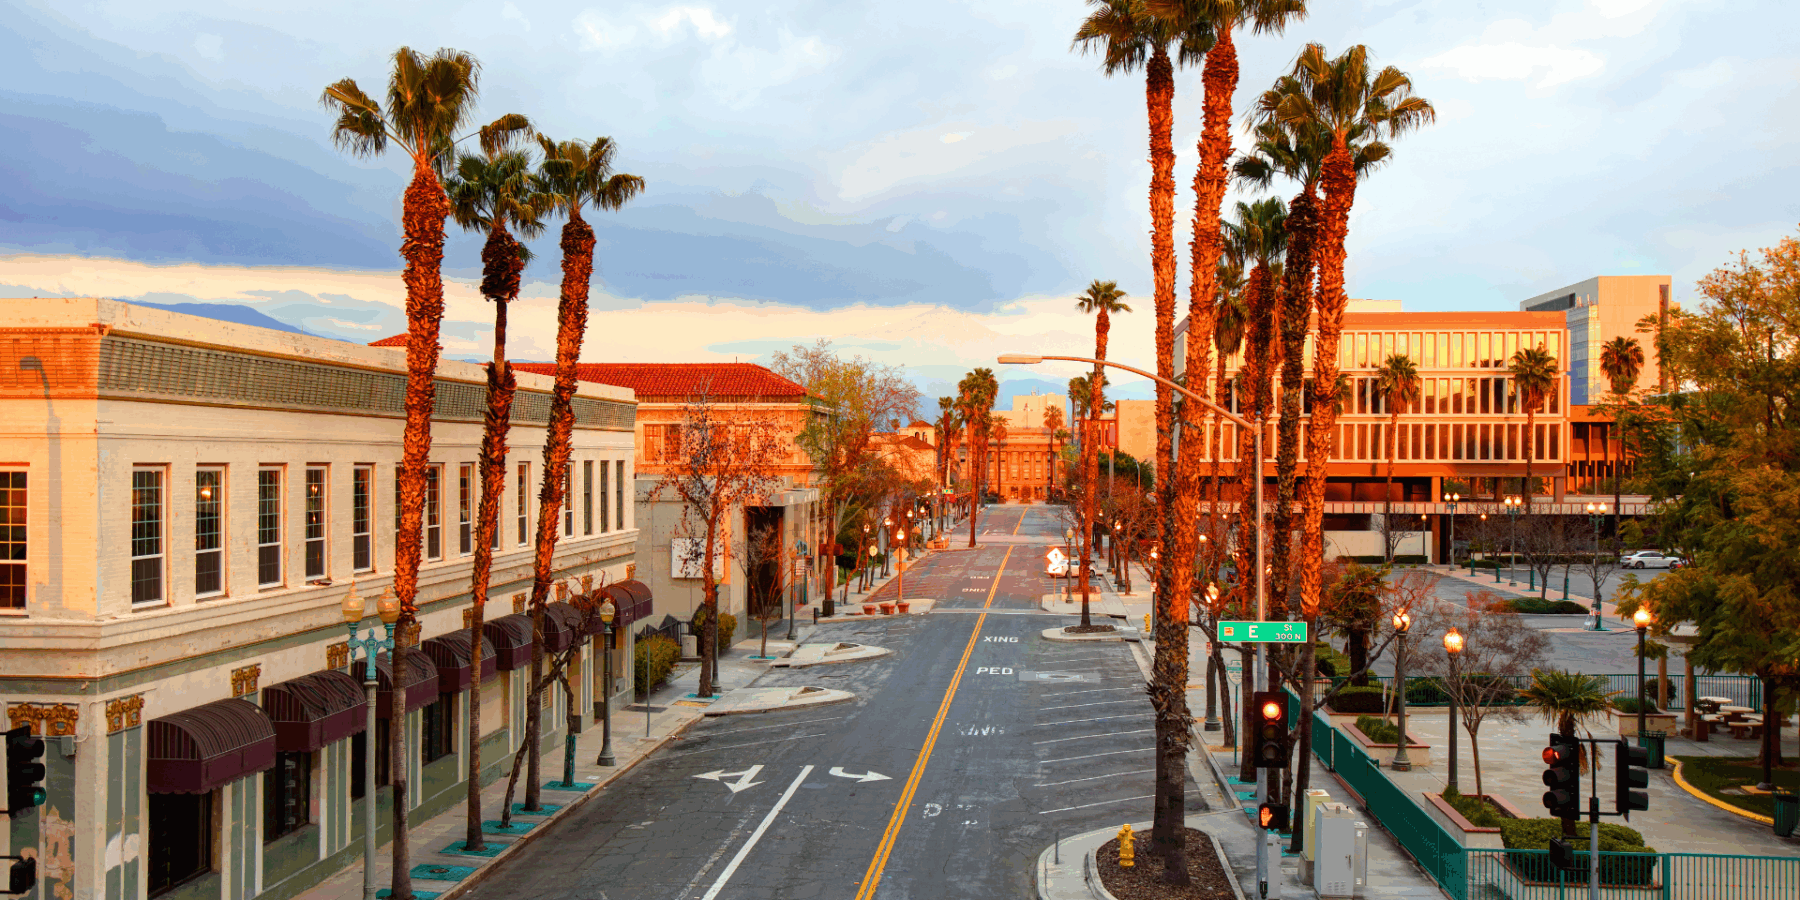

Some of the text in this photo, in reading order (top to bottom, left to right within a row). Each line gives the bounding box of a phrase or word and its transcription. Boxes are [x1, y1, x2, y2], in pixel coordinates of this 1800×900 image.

[1249, 624, 1293, 638] E St
[976, 667, 1014, 675] PED
